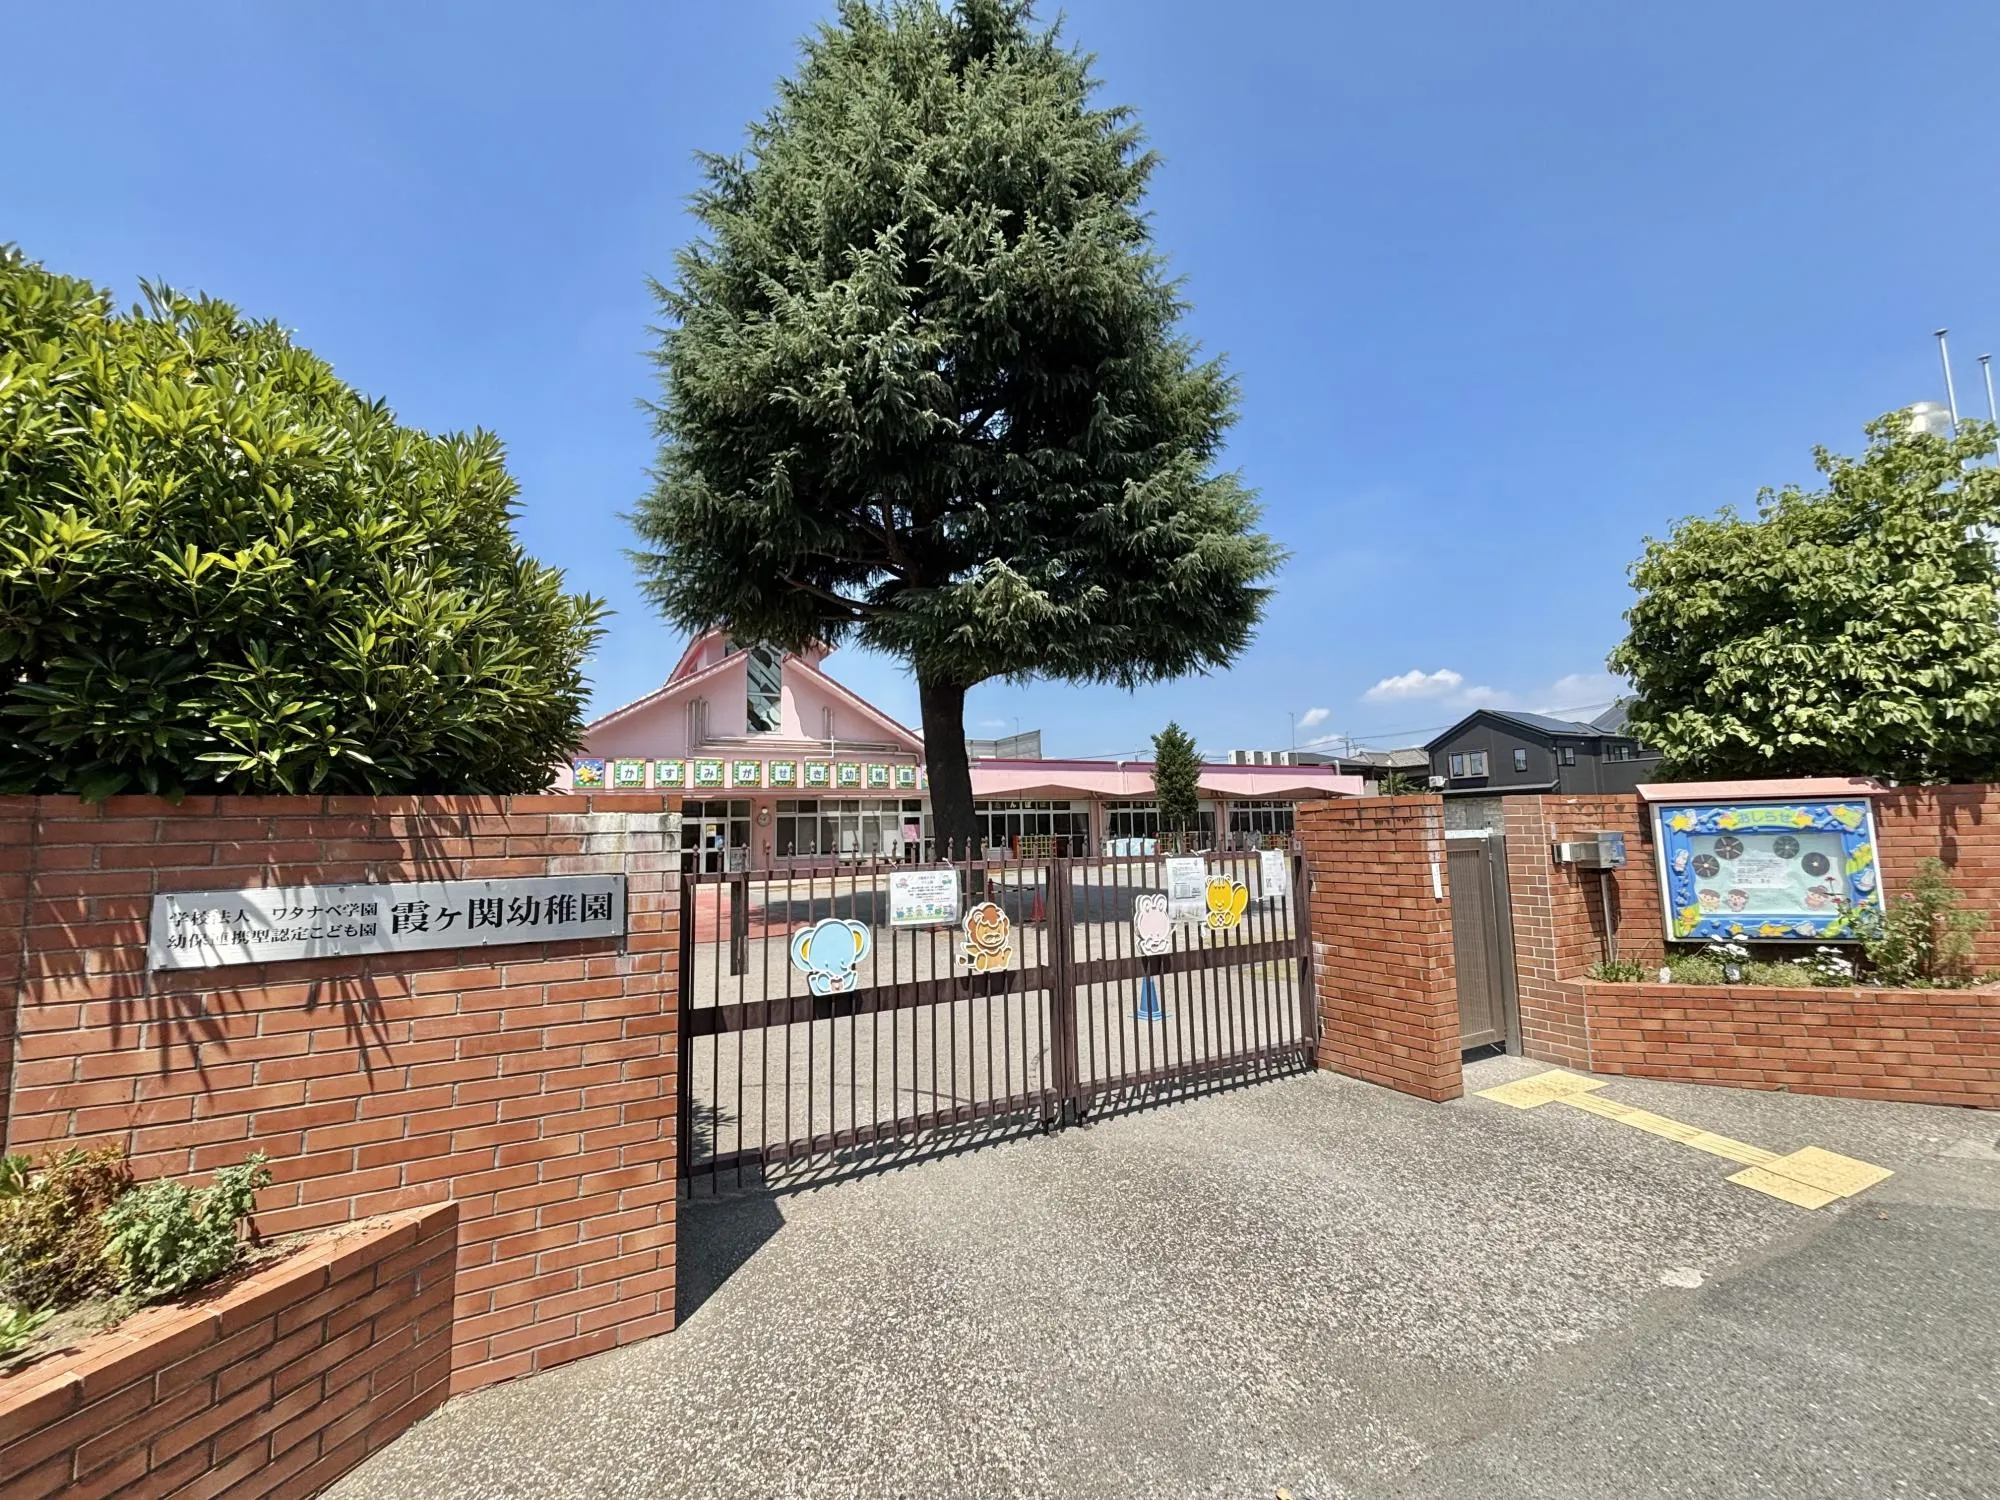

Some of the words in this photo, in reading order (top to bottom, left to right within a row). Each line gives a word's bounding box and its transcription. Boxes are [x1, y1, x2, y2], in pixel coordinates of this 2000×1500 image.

[624, 767, 912, 781] かすみがせき幼稚園
[1738, 810, 1793, 823] おしらせ
[168, 909, 250, 928] 学校法人
[272, 902, 378, 921] ワタナベ学園
